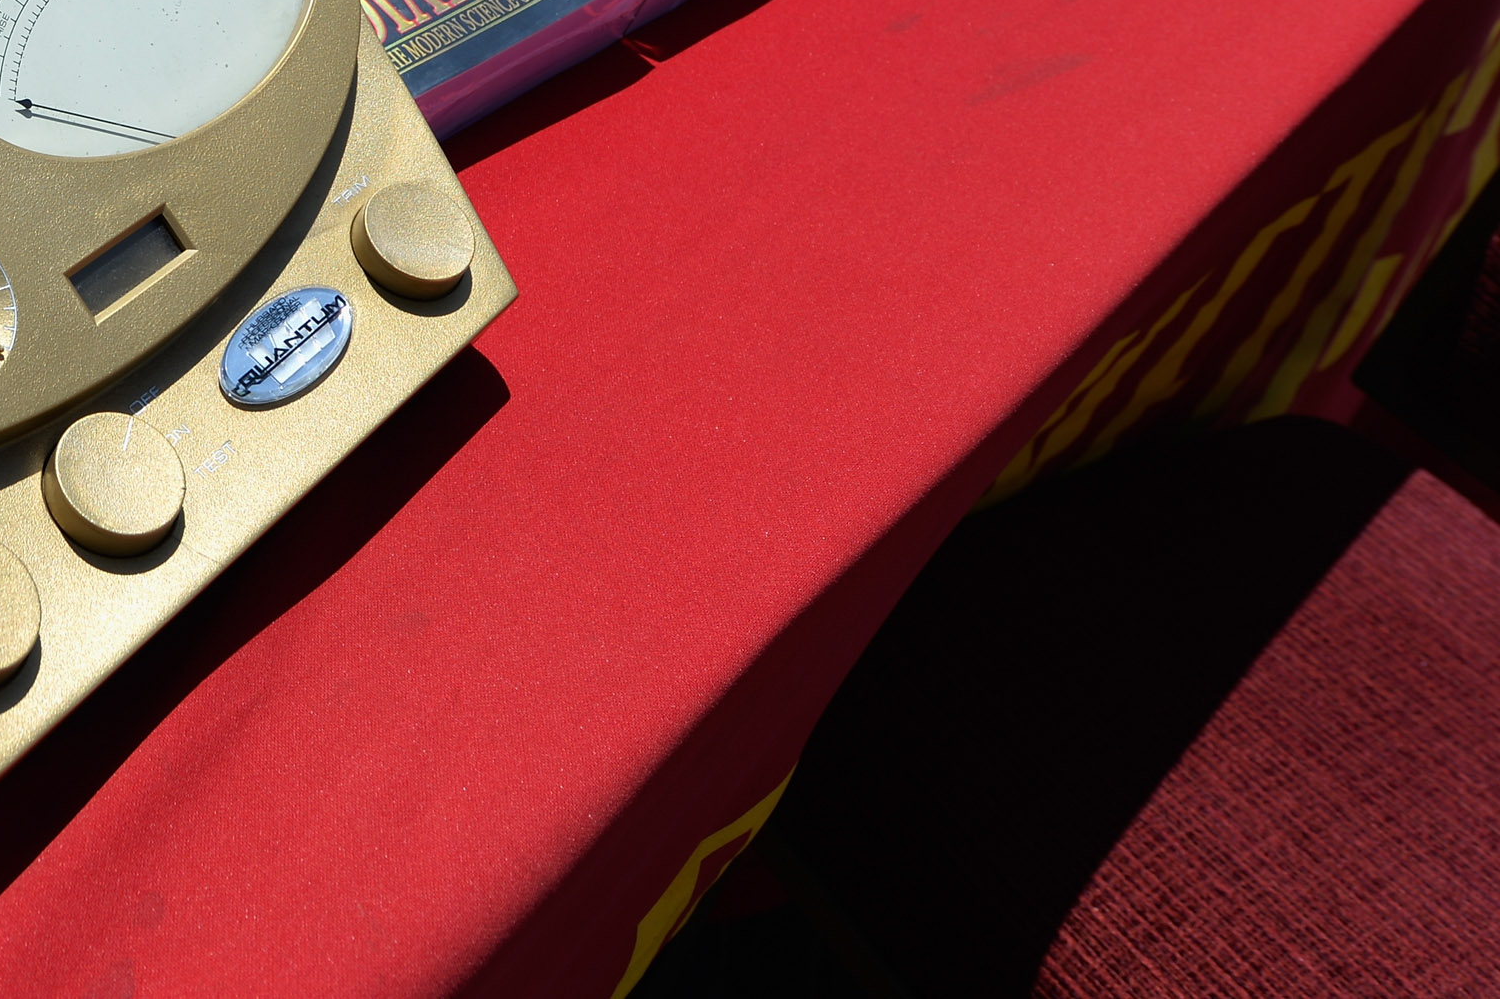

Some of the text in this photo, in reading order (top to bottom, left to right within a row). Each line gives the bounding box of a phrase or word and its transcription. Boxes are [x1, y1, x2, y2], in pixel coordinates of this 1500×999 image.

[385, 48, 414, 71] HE
[404, 17, 470, 65] MODERN
[332, 174, 374, 209] TRIM
[240, 292, 299, 345] PROFESSIONAL
[244, 295, 285, 333] HUBBARD
[235, 295, 346, 390] QUANTUM
[129, 386, 161, 416] OFF
[166, 422, 191, 448] ON
[192, 439, 237, 480] TEST
